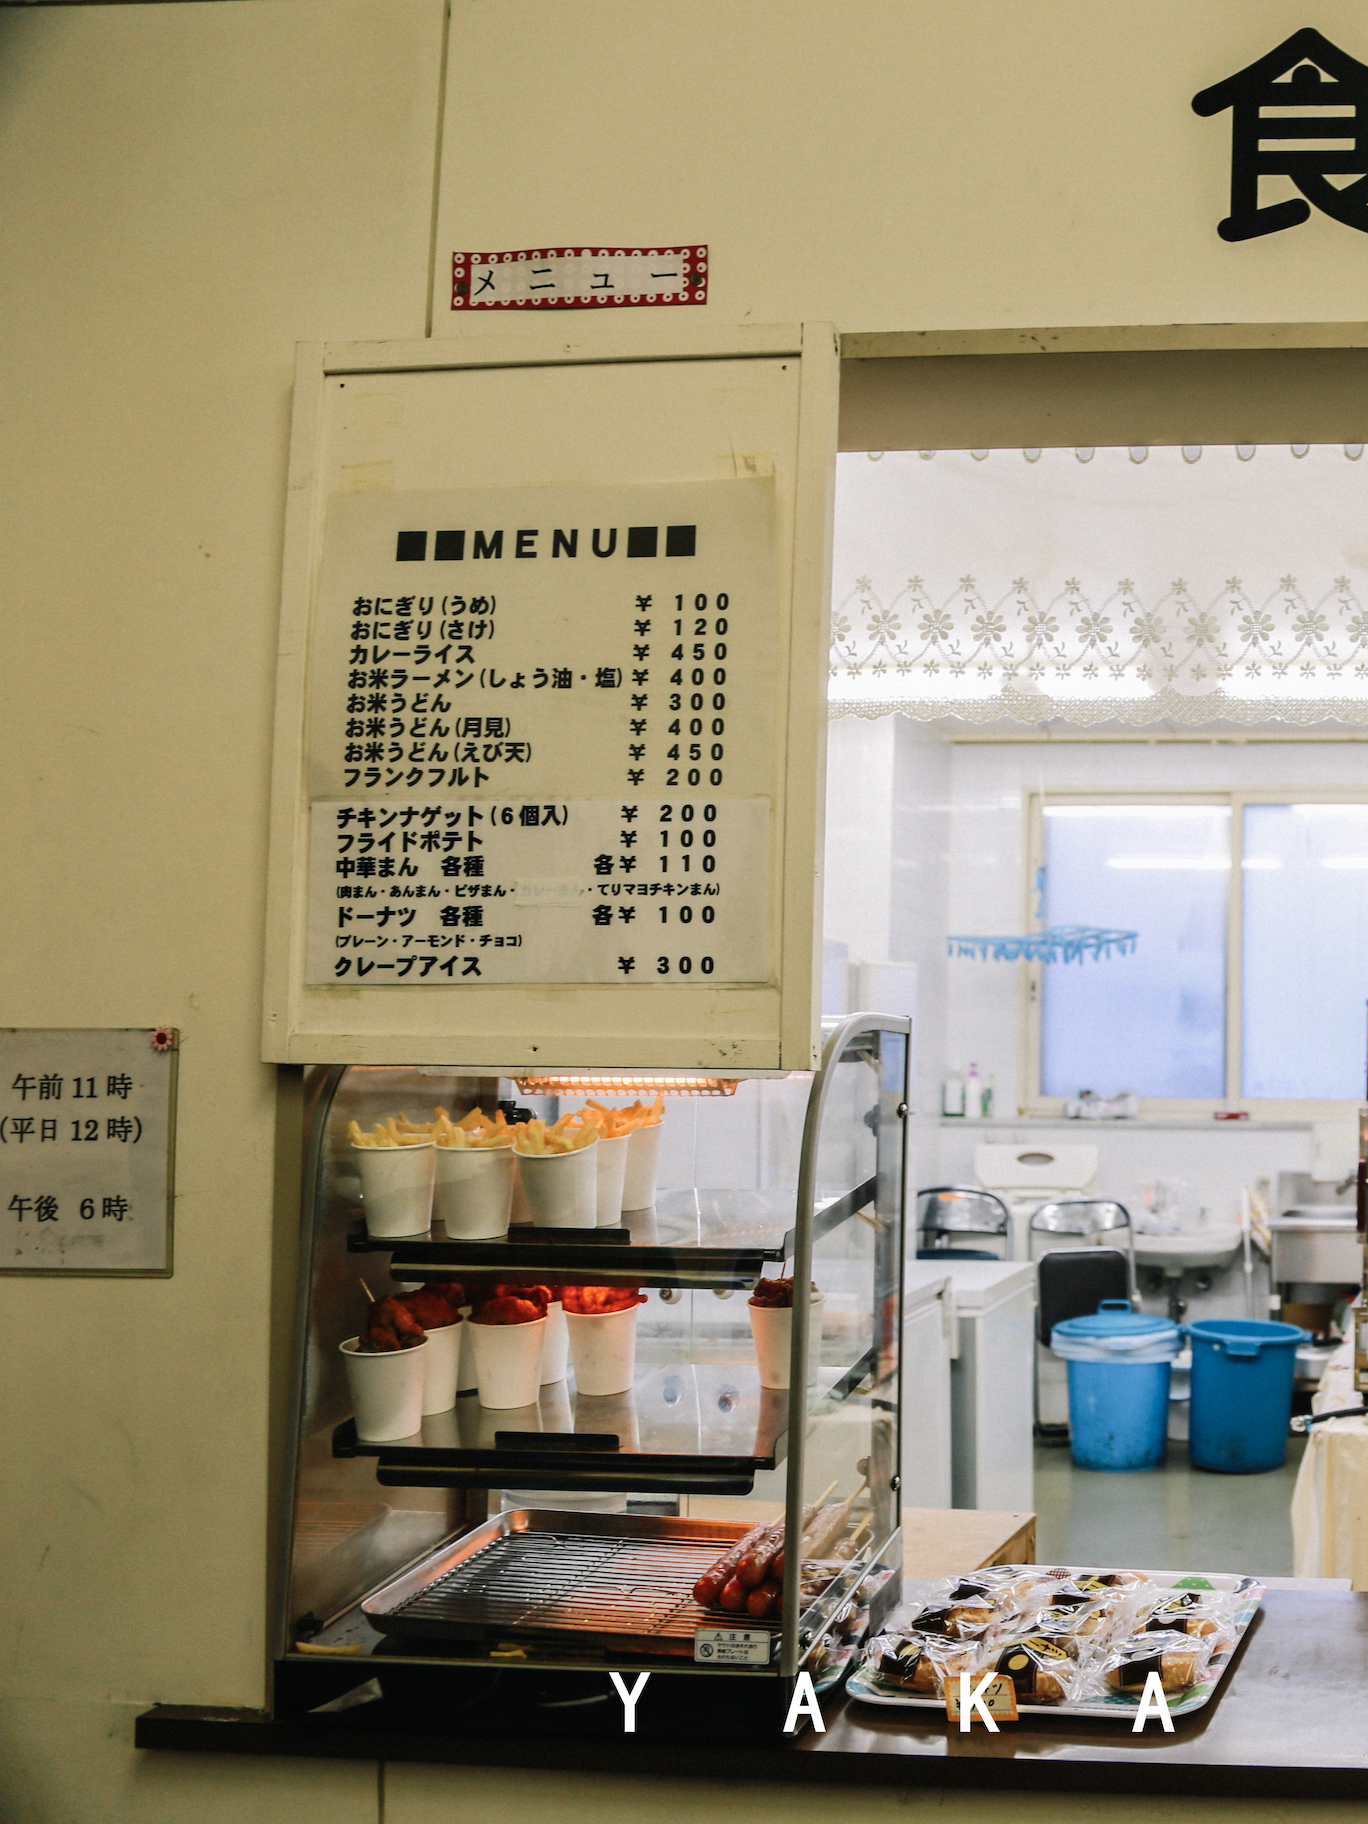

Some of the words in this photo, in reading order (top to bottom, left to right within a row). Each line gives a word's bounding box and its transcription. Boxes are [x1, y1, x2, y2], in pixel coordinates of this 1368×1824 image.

[474, 269, 679, 296] メニュー
[338, 831, 483, 853] フライドポテト
[335, 955, 481, 977] クレープアイス
